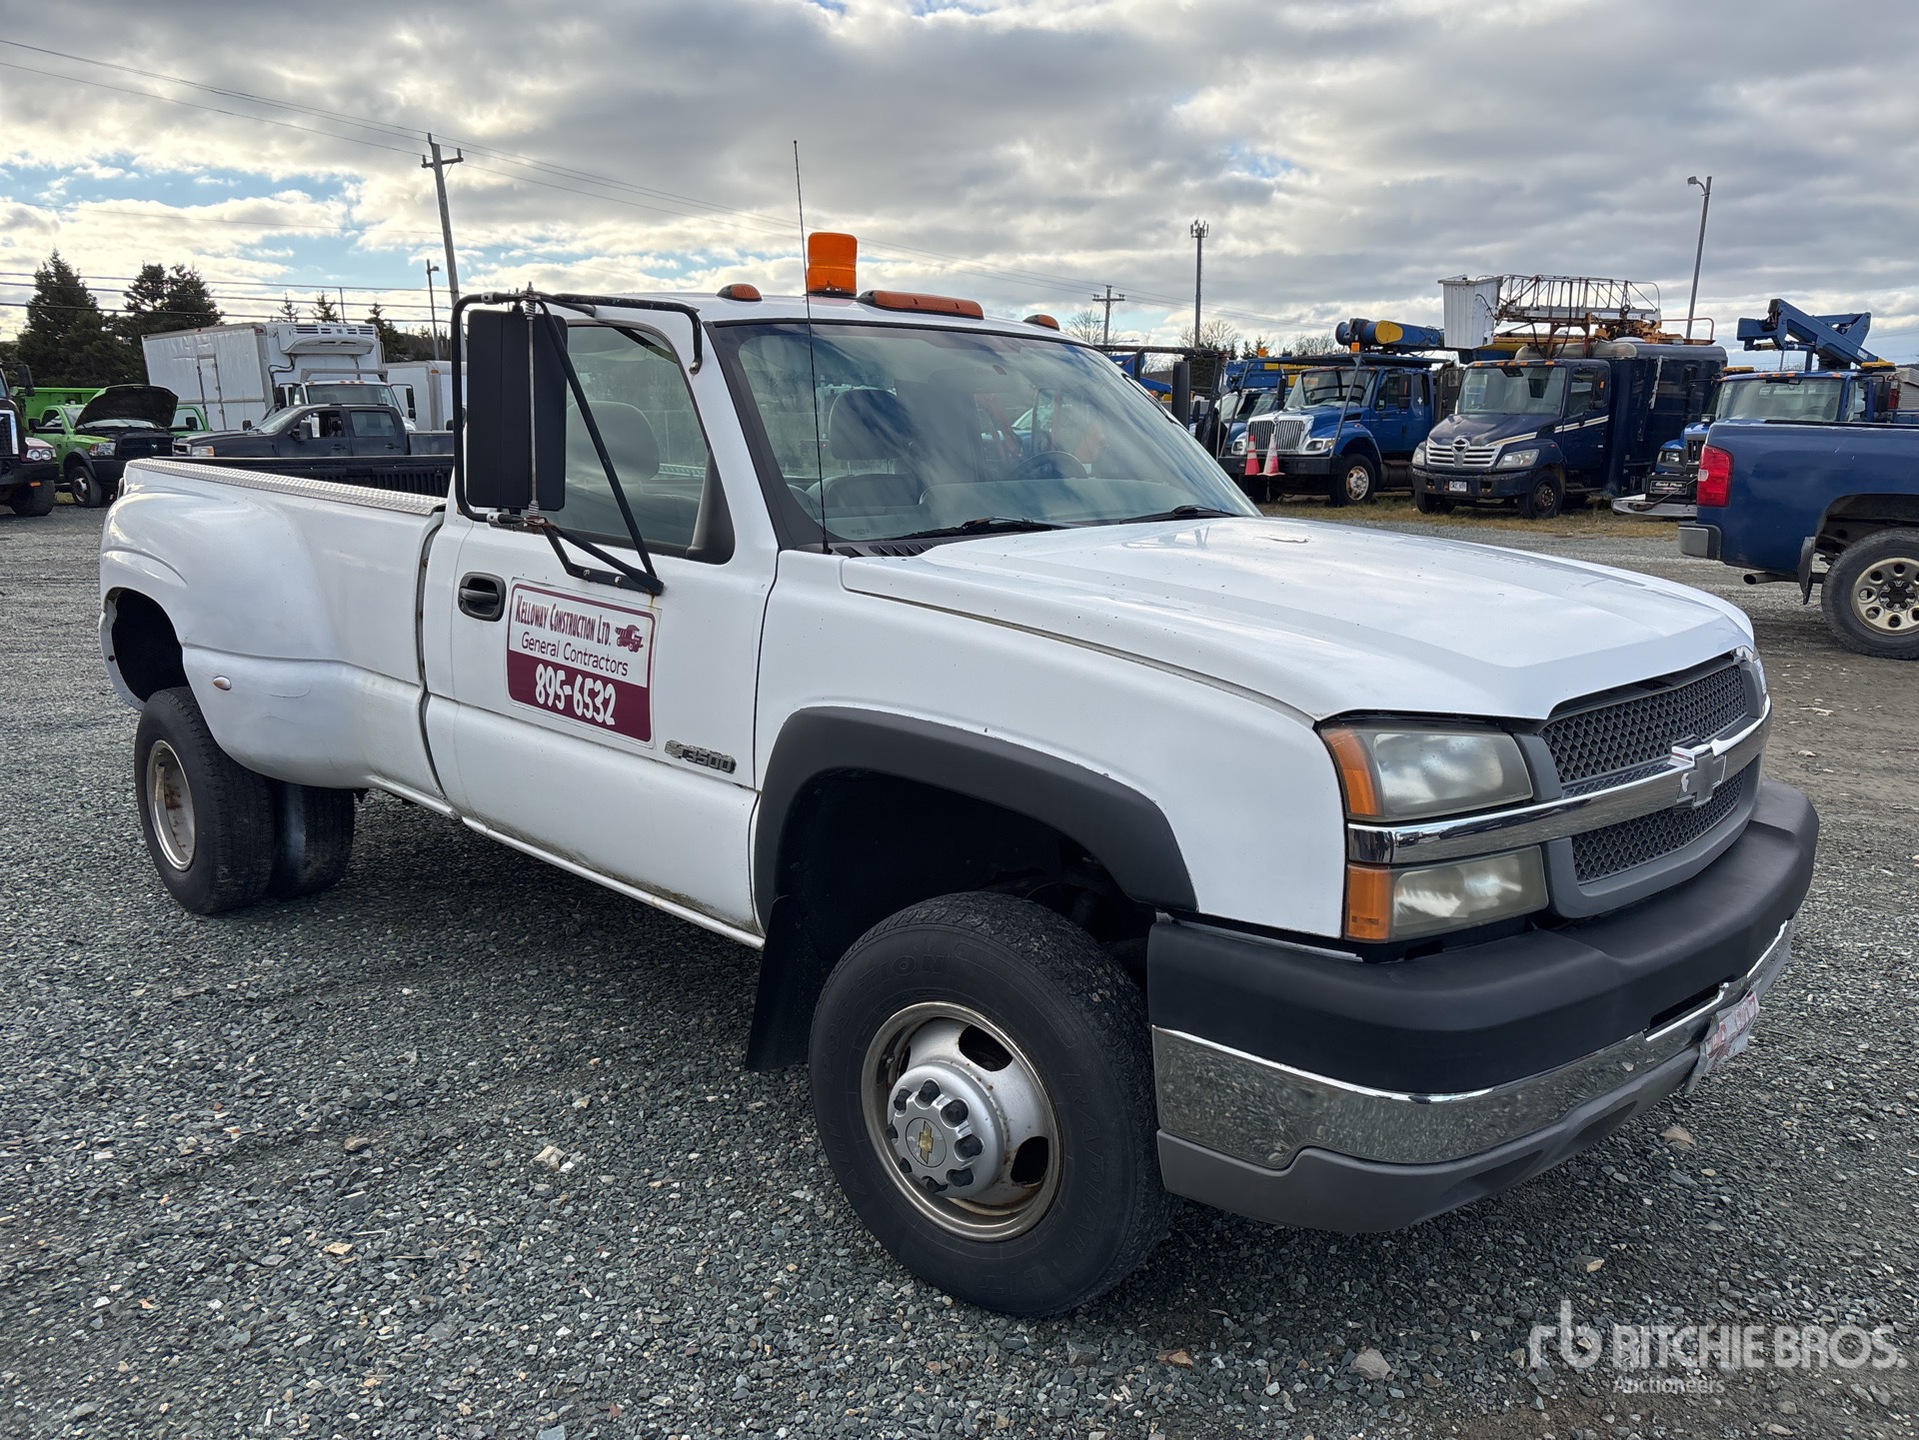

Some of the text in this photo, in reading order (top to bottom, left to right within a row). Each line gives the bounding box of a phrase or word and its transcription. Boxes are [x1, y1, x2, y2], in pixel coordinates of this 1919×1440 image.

[515, 595, 549, 629] KELLOWAY
[550, 603, 596, 641] CONSTRUCTION
[521, 631, 629, 677] General Contractors
[535, 663, 616, 726] 895-6532
[685, 745, 734, 774] 3500
